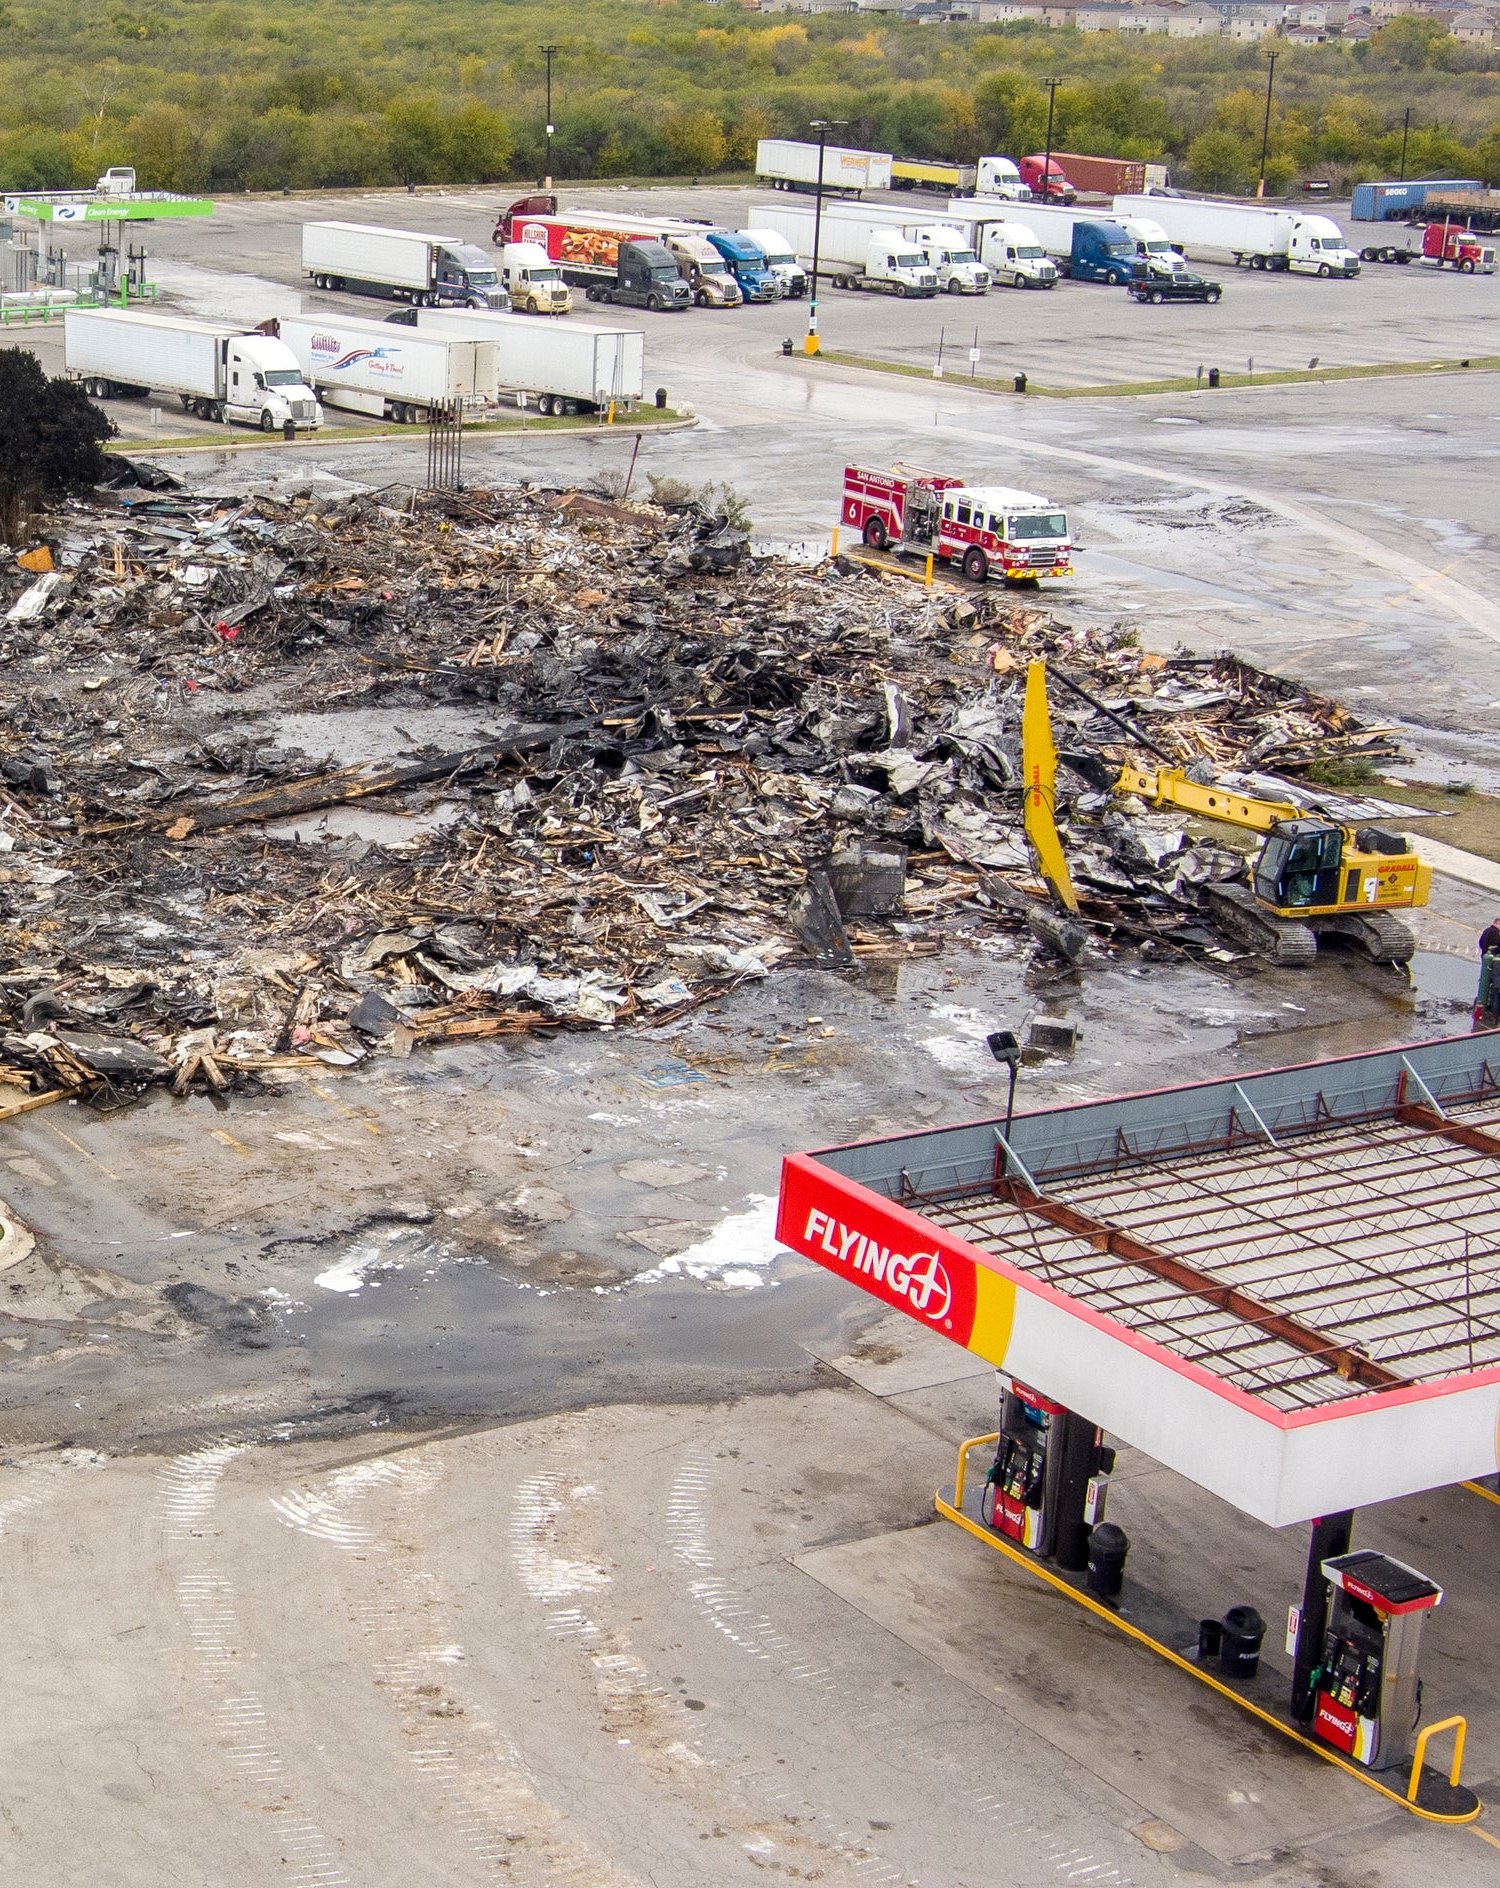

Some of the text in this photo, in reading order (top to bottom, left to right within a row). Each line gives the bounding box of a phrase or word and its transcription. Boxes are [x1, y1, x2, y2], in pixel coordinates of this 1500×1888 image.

[1385, 187, 1408, 196] seaco
[88, 207, 130, 216] Clean Energy
[857, 471, 895, 488] SAN ANTONIO
[848, 503, 856, 518] 6
[1377, 863, 1415, 874] GRADALL
